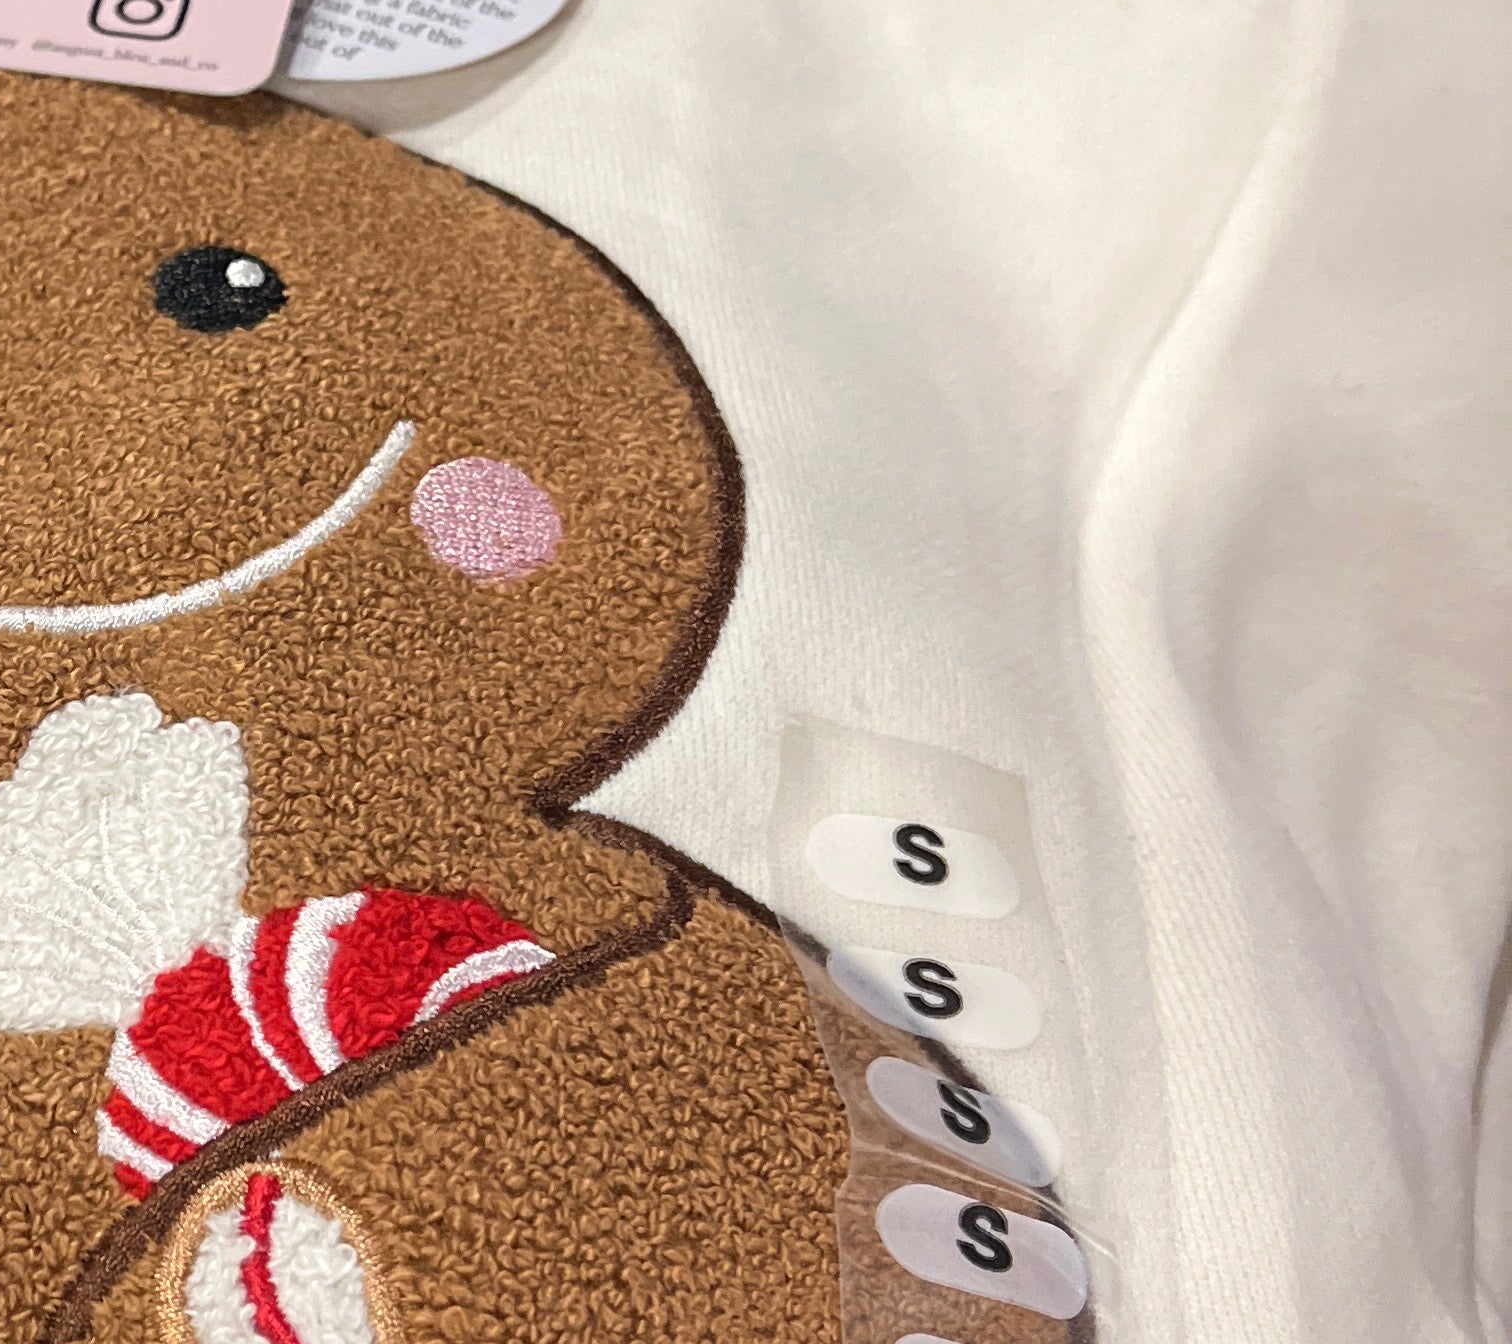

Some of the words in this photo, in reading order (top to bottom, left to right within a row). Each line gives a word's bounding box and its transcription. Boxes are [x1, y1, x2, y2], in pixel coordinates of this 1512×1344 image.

[892, 822, 949, 886] S
[902, 958, 964, 1019] S
[937, 1079, 992, 1146] S
[955, 1202, 1014, 1274] S
